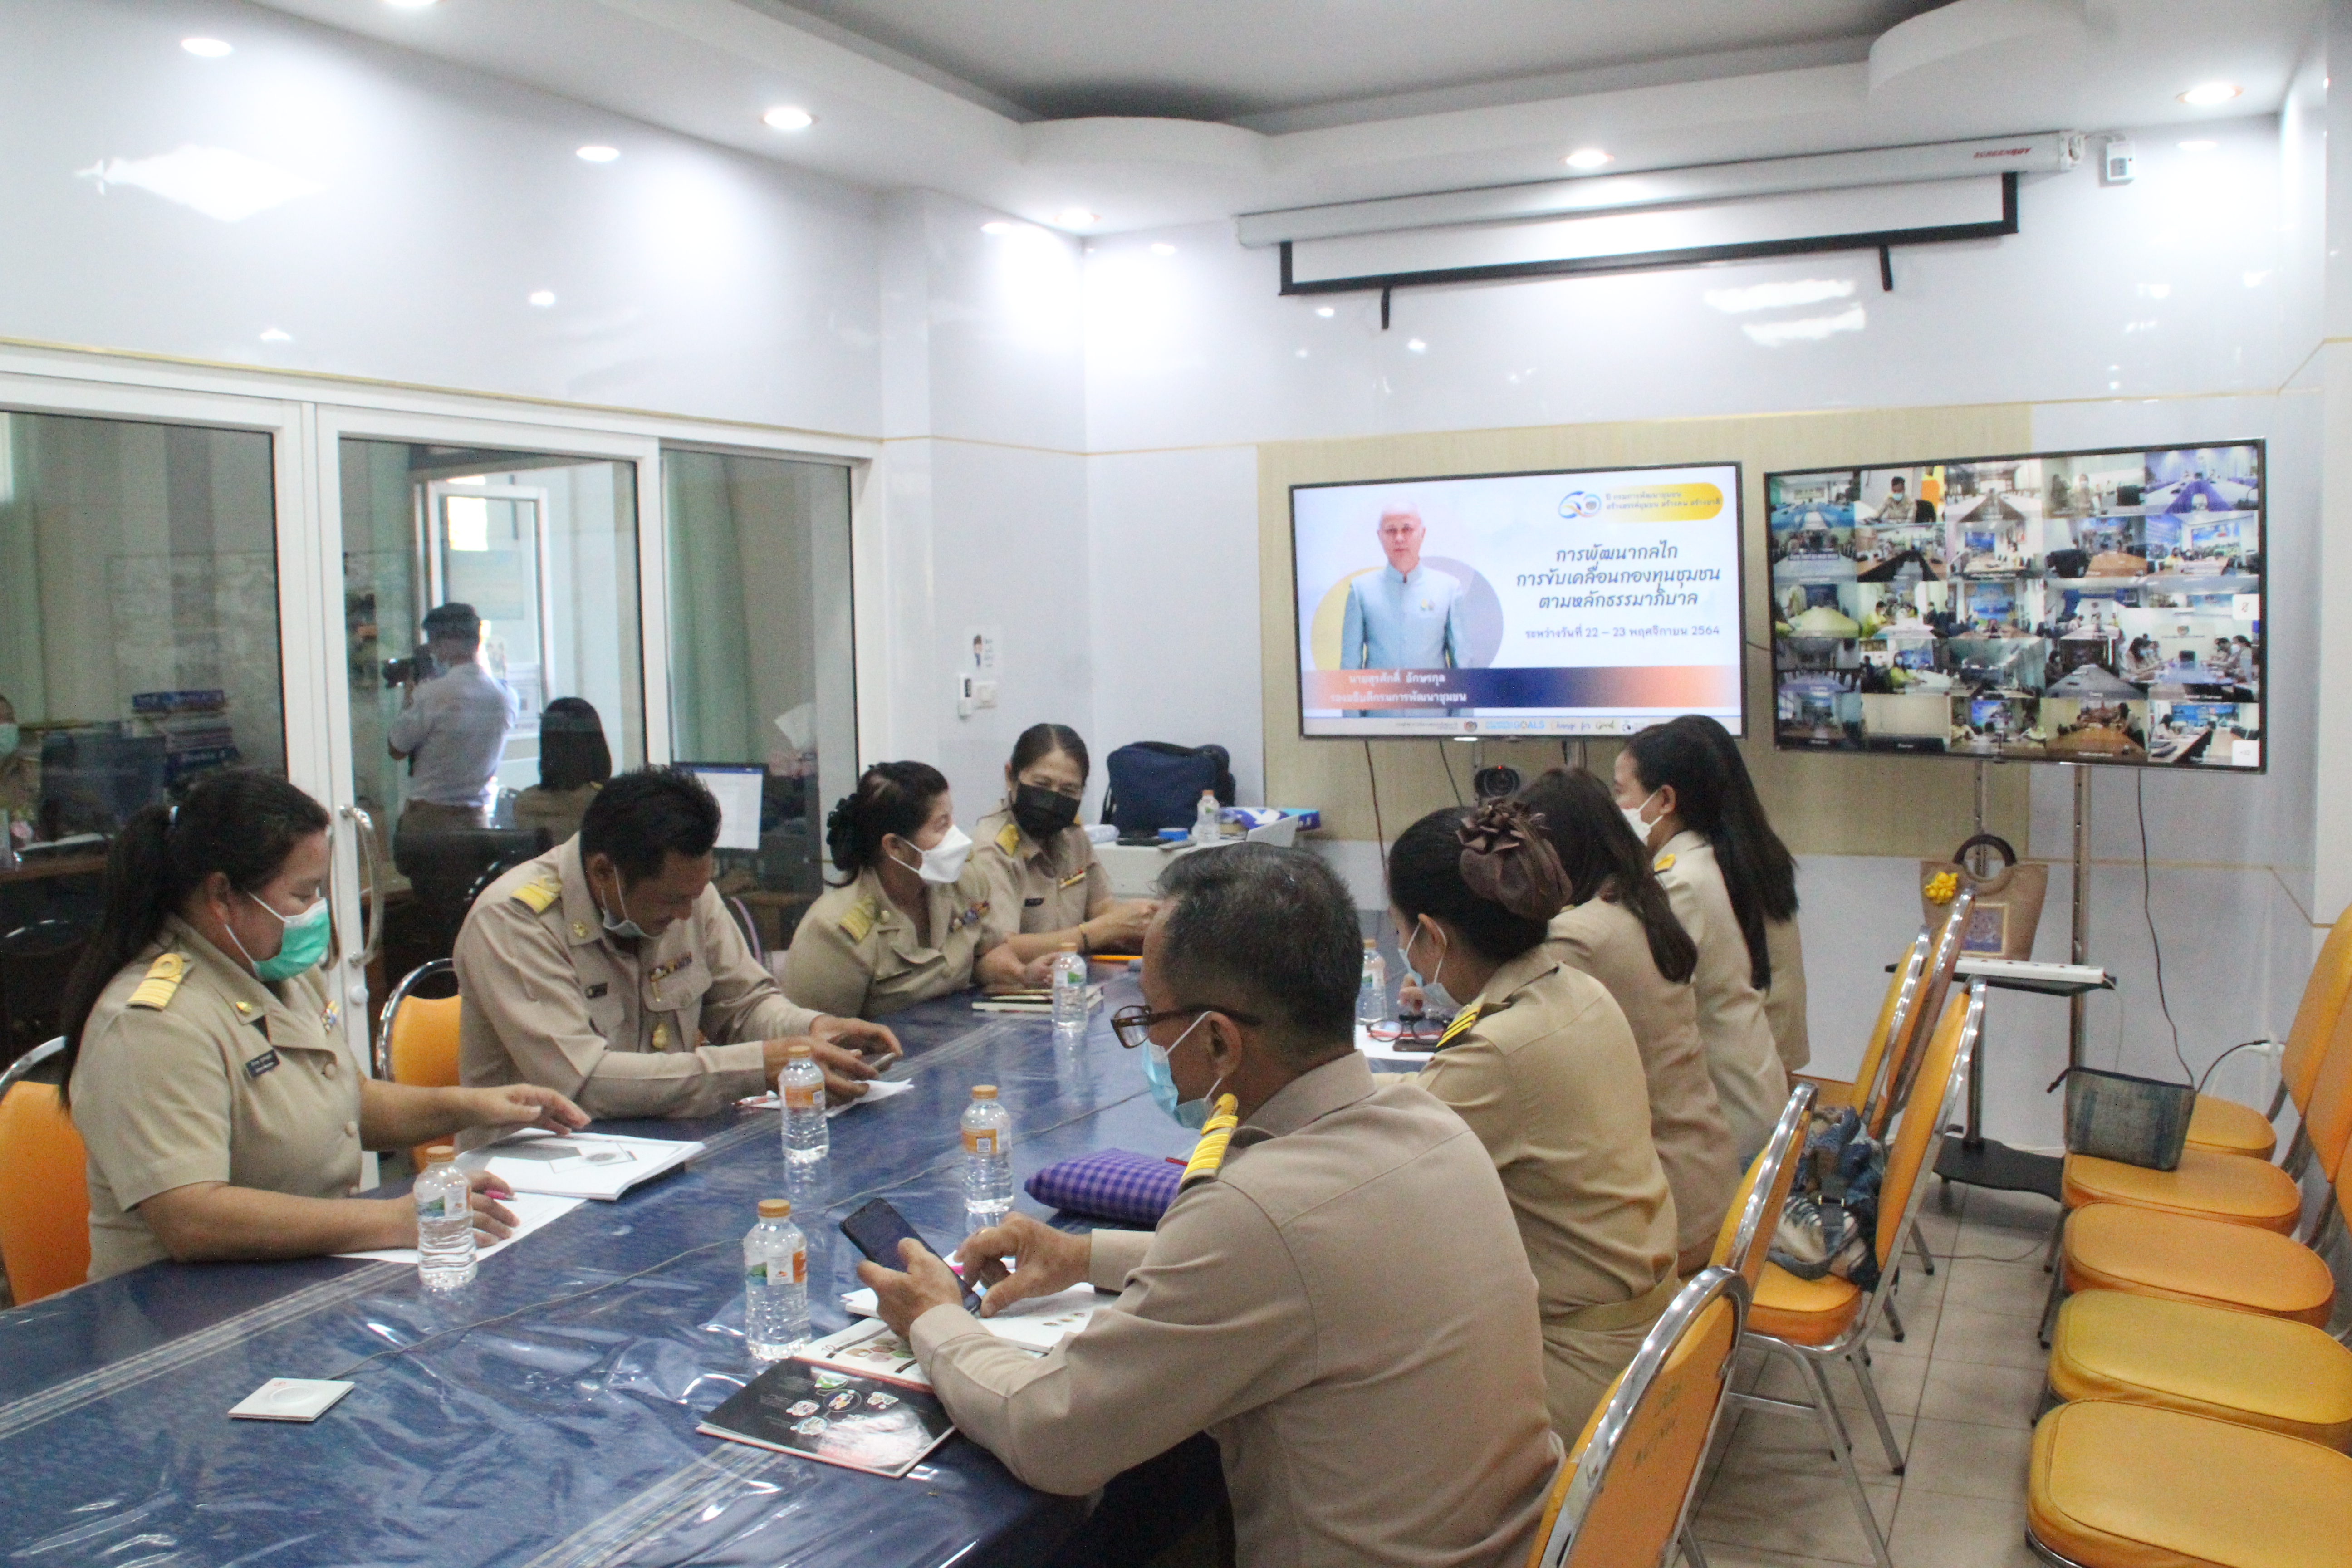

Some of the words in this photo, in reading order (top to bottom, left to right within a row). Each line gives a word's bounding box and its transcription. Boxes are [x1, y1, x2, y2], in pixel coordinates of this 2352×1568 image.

[1557, 540, 1678, 562] การพัฒนากลไก
[1517, 562, 1721, 589] การขับเคลื่อนกองทุนชุมชน
[1539, 589, 1698, 608] ตามหลักธรรมาภิบาล
[1586, 627, 1598, 637] 22
[1613, 627, 1625, 637] 23
[1691, 625, 1720, 636] 2564
